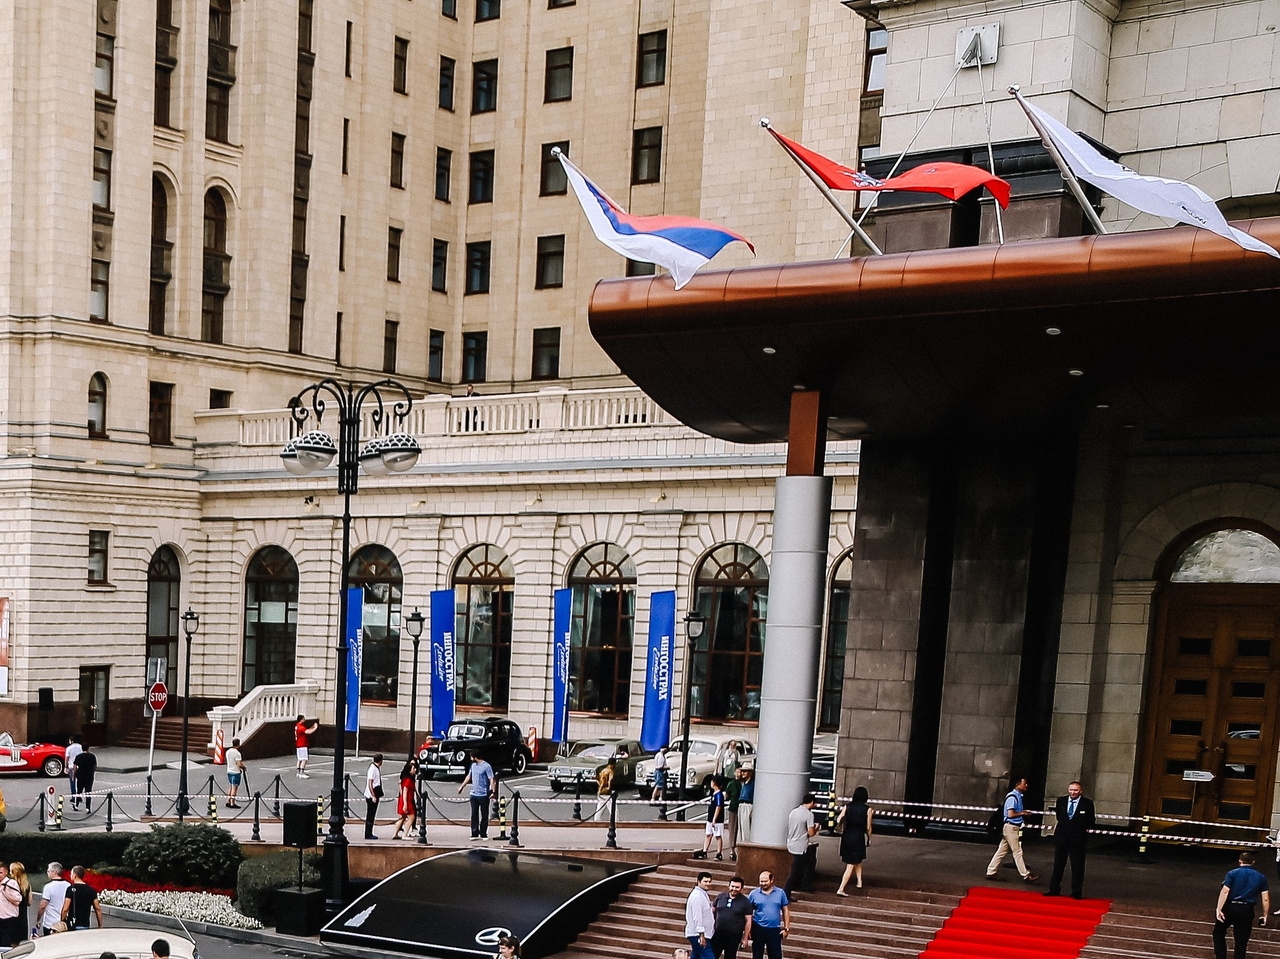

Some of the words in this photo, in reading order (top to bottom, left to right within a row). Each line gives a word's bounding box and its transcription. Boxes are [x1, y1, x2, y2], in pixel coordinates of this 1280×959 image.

[443, 631, 455, 692] ИНГОССТРАХ
[658, 635, 670, 701] ИНГОССТРАХ
[150, 692, 166, 702] STOP
